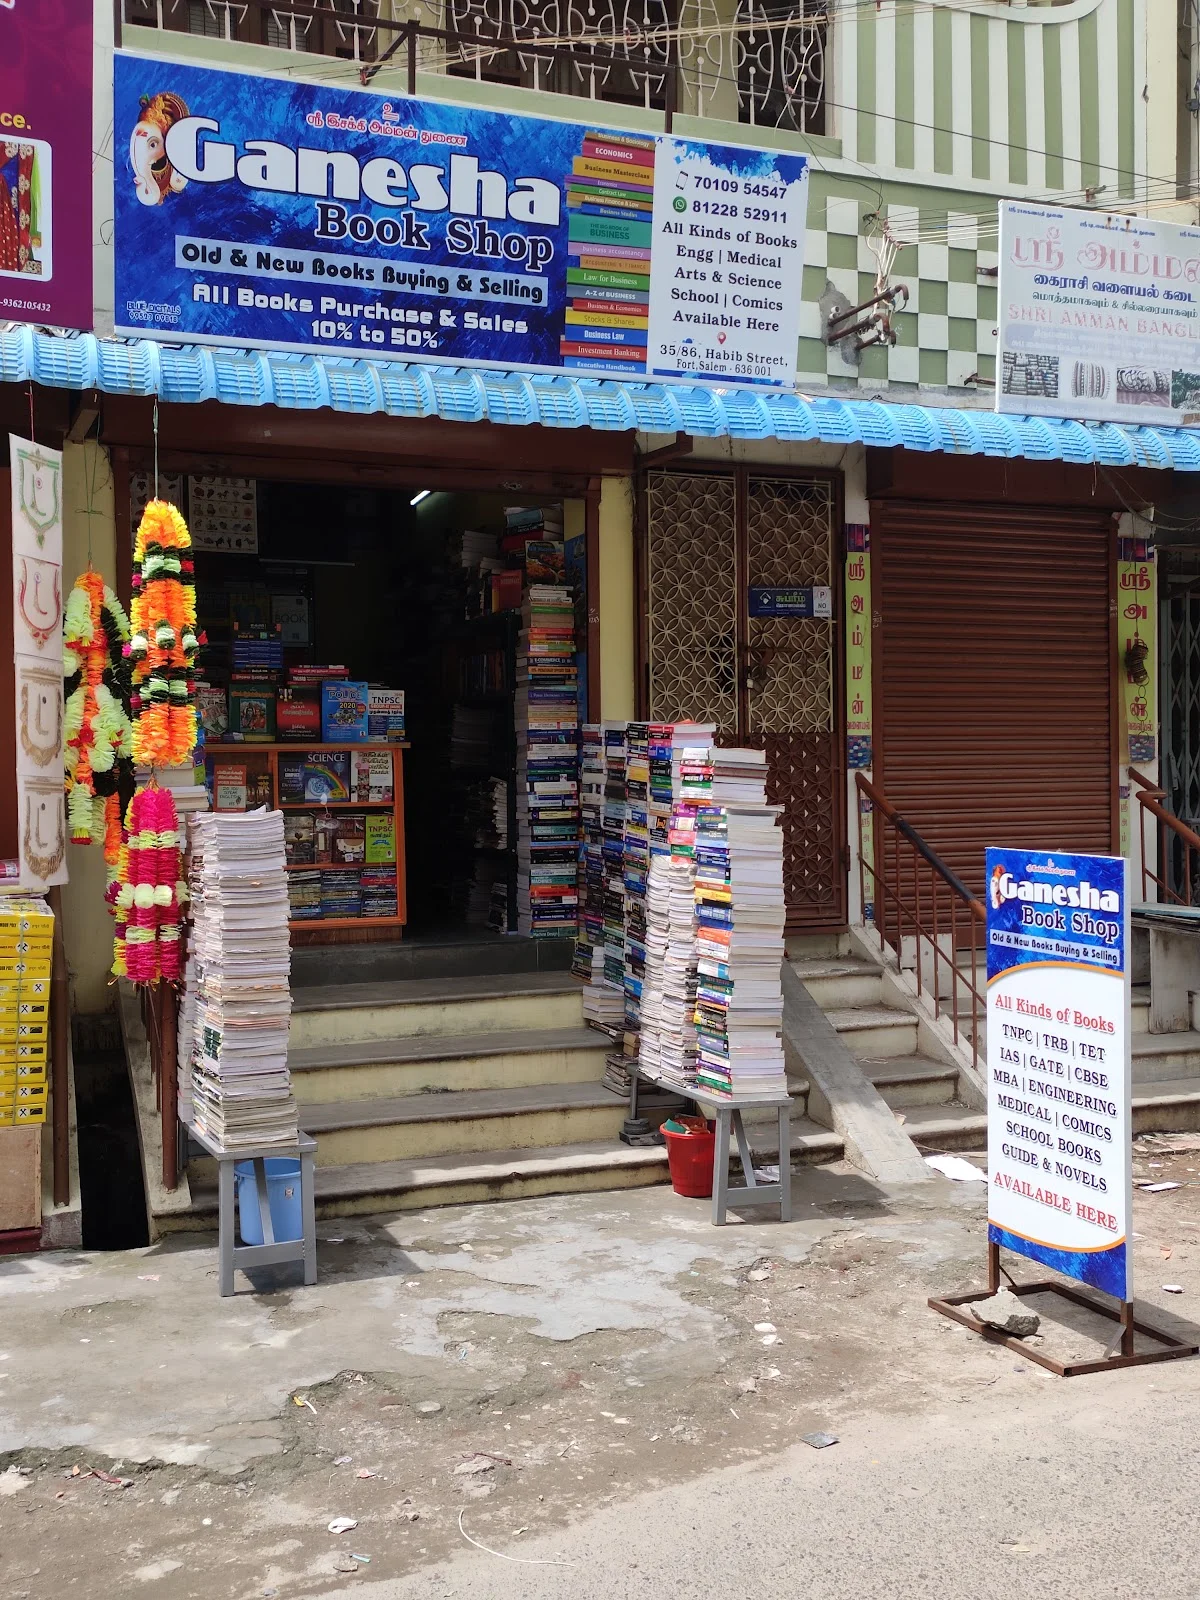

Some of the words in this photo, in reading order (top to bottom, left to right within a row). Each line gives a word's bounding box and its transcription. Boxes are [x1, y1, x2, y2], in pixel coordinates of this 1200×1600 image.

[327, 113, 367, 132] இசக்கி
[369, 121, 417, 139] அம்மன்
[420, 130, 467, 147] துணை
[595, 147, 633, 160] ECONOMICS
[165, 116, 560, 226] Ganesha
[584, 164, 612, 174] Business
[614, 168, 650, 179] Masterclass
[598, 180, 618, 188] Economics
[598, 188, 617, 196] Contract
[694, 176, 738, 192] 70109
[744, 183, 787, 199] 54547
[600, 208, 620, 216] Business
[620, 210, 638, 218] Studies
[692, 200, 738, 217] 81228
[744, 206, 787, 224] 52911
[316, 202, 429, 249] Book
[446, 218, 553, 271] Shop
[590, 229, 630, 240] BUSINESS
[662, 221, 683, 235] All
[689, 224, 731, 240] Kinds
[736, 231, 751, 243] of
[756, 233, 797, 249] Books
[608, 248, 644, 257] accountancy
[676, 245, 714, 263] Engg
[727, 250, 782, 268] Medical
[182, 243, 222, 264] Old
[230, 249, 248, 267] &
[257, 252, 303, 273] New
[312, 258, 374, 281] Books
[383, 266, 449, 293] Buying
[457, 275, 473, 292] &
[480, 277, 543, 303] Selling
[584, 273, 598, 281] Law
[600, 274, 608, 282] for
[610, 276, 638, 285] Business
[674, 267, 706, 281] Arts
[712, 271, 723, 283] &
[728, 272, 782, 290] Science
[606, 292, 636, 300] BUSINESS
[671, 288, 719, 304] School
[732, 294, 783, 311] Comics
[1034, 273, 1089, 291] கைராசி
[1092, 282, 1160, 299] வளையல்
[1162, 290, 1197, 303] கடை
[193, 283, 229, 305] All
[237, 288, 313, 313] Books
[320, 296, 433, 325] Purchase
[440, 310, 457, 328] &
[463, 311, 528, 334] Sales
[587, 302, 608, 310] Business
[616, 305, 642, 313] Economics
[1032, 292, 1109, 309] மொத்தமாகவும்
[1112, 301, 1119, 309] &
[584, 315, 605, 324] Stocks
[614, 318, 635, 326] Shares
[673, 310, 741, 327] Available
[746, 318, 779, 332] Here
[1009, 304, 1053, 323] SHRI
[1062, 310, 1129, 332] AMMAN
[312, 320, 353, 340] 10%
[360, 325, 385, 343] to
[391, 327, 438, 349] 50%
[584, 330, 611, 339] Business
[612, 332, 625, 341] Law
[578, 346, 612, 355] Investment
[614, 348, 640, 359] Banking
[660, 344, 701, 359] 35/86,
[706, 349, 743, 362] Habib
[746, 353, 788, 367] Street,
[735, 365, 753, 374] 636
[754, 366, 771, 376] 001
[372, 696, 401, 704] TNPSC
[308, 753, 345, 763] SCIENCE
[999, 873, 1120, 913] Ganesha
[1022, 906, 1065, 930] Book
[1072, 914, 1119, 943] Shop
[992, 932, 1004, 942] Old
[1014, 937, 1029, 946] New
[1032, 940, 1053, 951] Books
[1056, 943, 1080, 958] Buying
[1083, 948, 1089, 957] &
[1092, 950, 1118, 965] Selling
[995, 994, 1012, 1009] All
[1016, 998, 1052, 1018] Kinds
[1056, 1008, 1070, 1022] of
[1074, 1010, 1114, 1033] Books
[1002, 1024, 1033, 1042] TNPC
[1043, 1034, 1068, 1051] TRB
[1079, 1042, 1106, 1061] TET
[1000, 1047, 1020, 1063] IAS
[1030, 1055, 1064, 1075] GATE
[1074, 1067, 1108, 1087] CBSE
[994, 1068, 1019, 1087] MBA
[1028, 1078, 1117, 1116] ENGINEERING
[998, 1094, 1052, 1121] MEDICAL
[1062, 1114, 1112, 1141] COMICS
[1006, 1120, 1054, 1147] SCHOOL
[1058, 1138, 1101, 1163] BOOKS
[1002, 1143, 1039, 1166] GUIDE
[1043, 1158, 1051, 1171] &
[1056, 1162, 1107, 1191] NOVELS
[994, 1172, 1071, 1212] AVAILABLE
[1076, 1202, 1118, 1231] HERE
